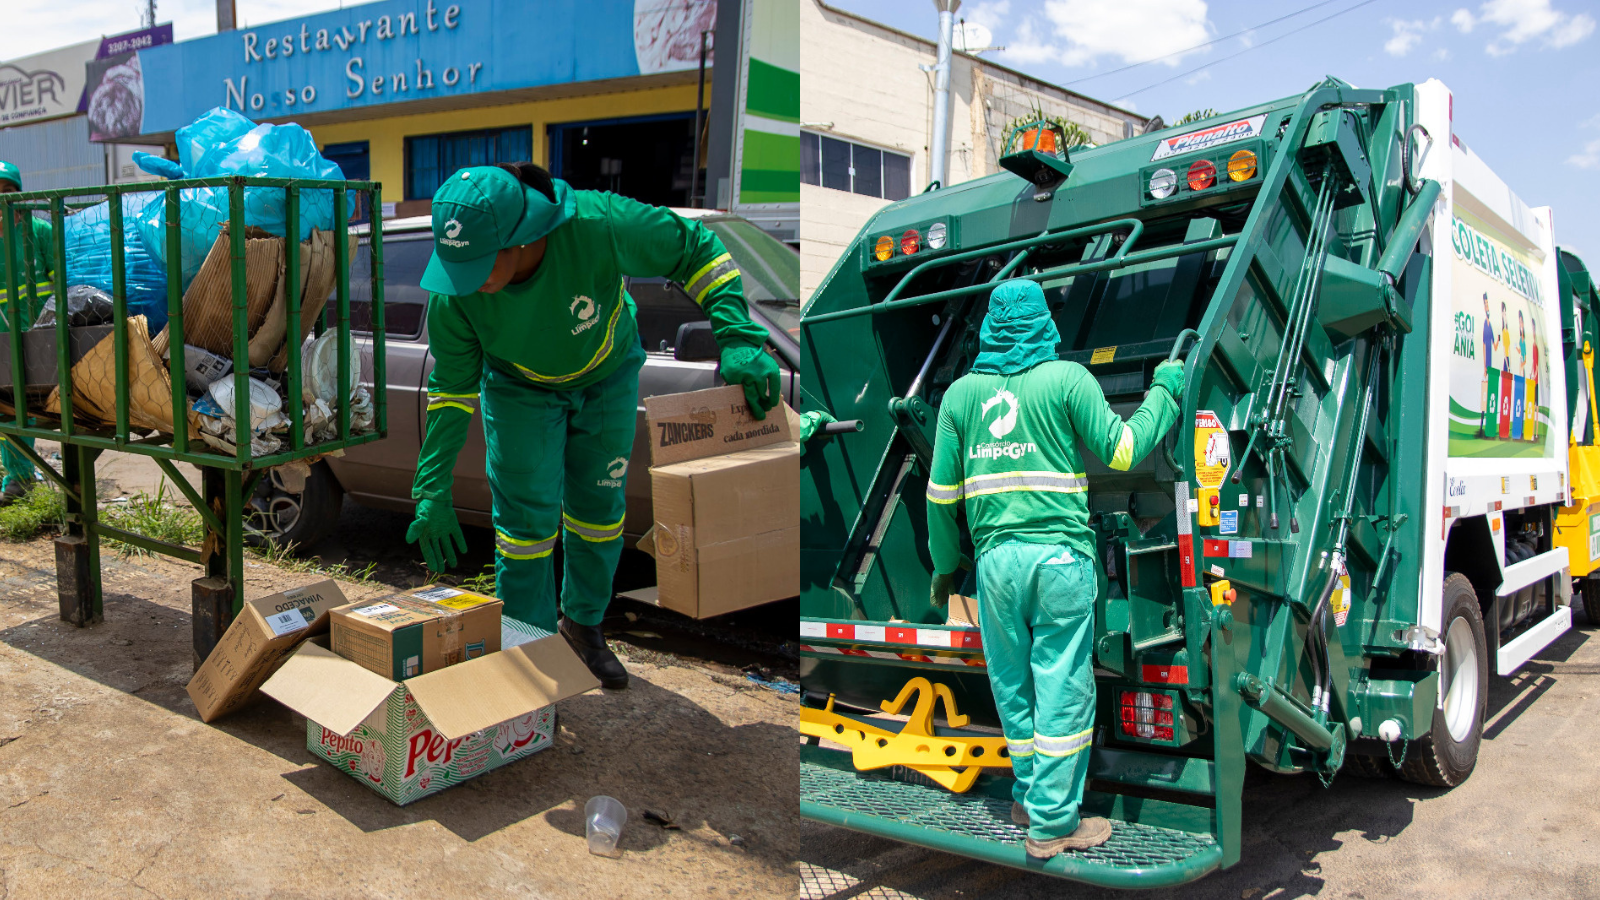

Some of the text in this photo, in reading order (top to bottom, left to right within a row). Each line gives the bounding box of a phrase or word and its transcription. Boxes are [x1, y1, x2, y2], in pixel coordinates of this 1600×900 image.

[243, 0, 461, 63] Restaurante
[223, 57, 482, 111] Noso Senhor
[1173, 121, 1249, 149] Planalto
[1452, 217, 1502, 280] COLETA
[657, 422, 714, 447] ZANCKERS
[723, 423, 780, 443] cada mordida
[969, 442, 1037, 460] LimpaGyn
[275, 593, 324, 613] VIMACEDO
[321, 727, 364, 754] Pepito
